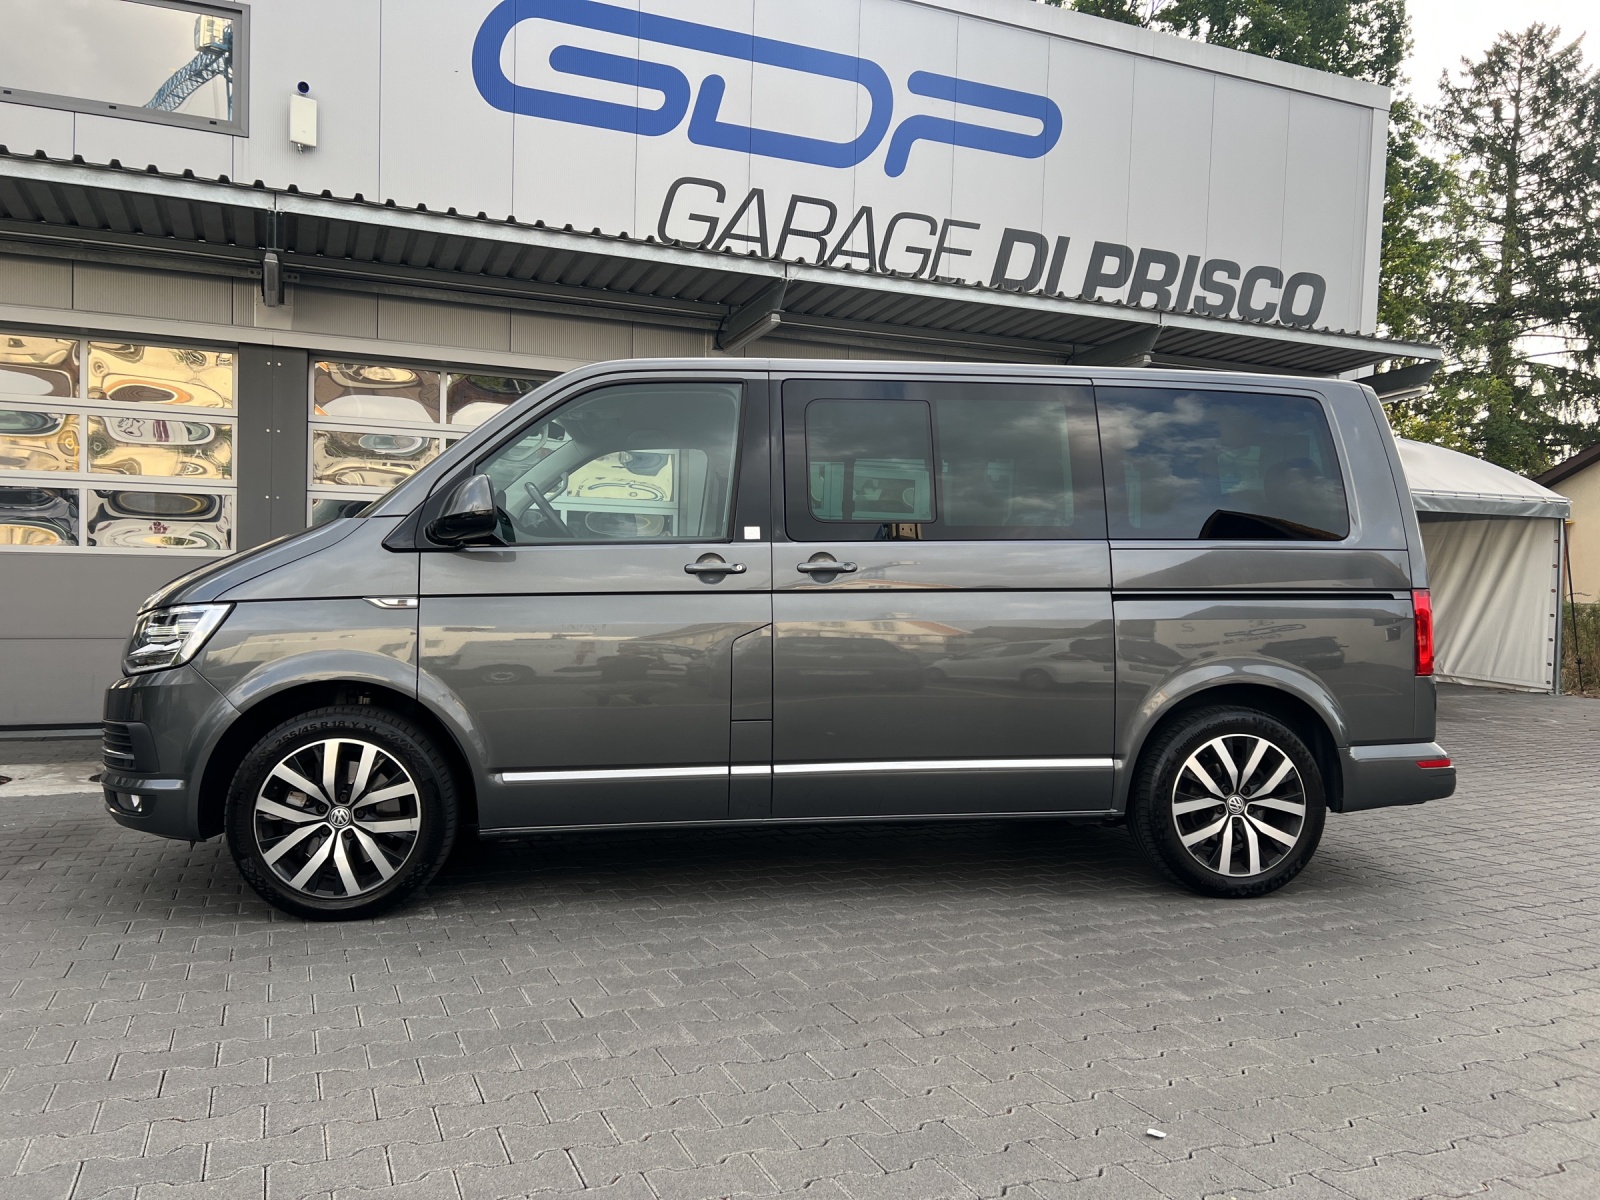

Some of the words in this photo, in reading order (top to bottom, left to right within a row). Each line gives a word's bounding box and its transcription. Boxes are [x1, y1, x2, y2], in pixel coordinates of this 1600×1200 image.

[472, 0, 1063, 177] GDP
[657, 176, 981, 283] GARAGE
[989, 227, 1070, 295] DI
[1082, 240, 1327, 327] PRISCO
[275, 723, 318, 746] 255/45
